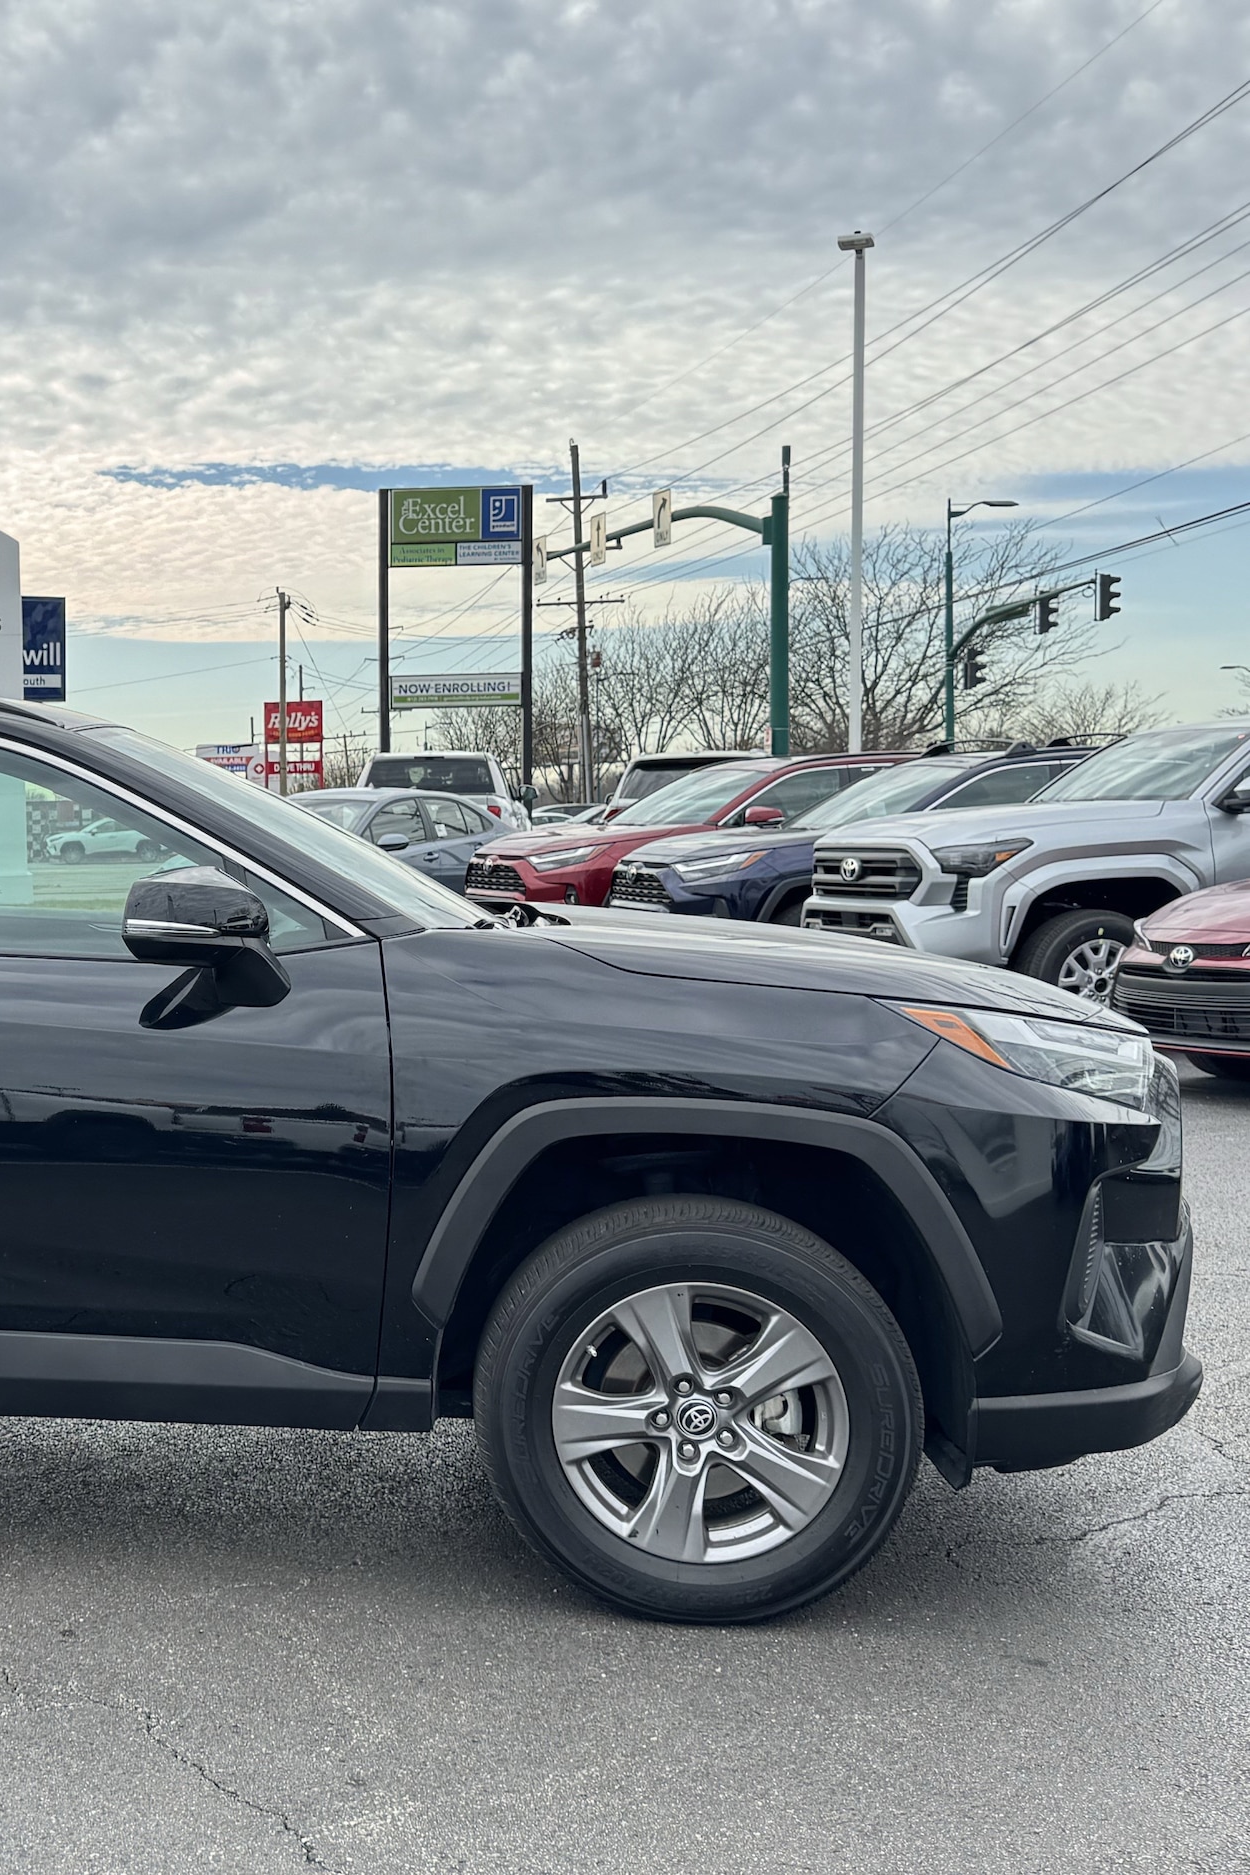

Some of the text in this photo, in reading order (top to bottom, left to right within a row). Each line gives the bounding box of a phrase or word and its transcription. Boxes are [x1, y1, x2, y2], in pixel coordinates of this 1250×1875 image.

[407, 495, 465, 519] Excel
[398, 514, 475, 534] Center
[398, 682, 510, 694] NOW ENROLLING!
[273, 762, 315, 772] DVE THRU
[842, 1361, 896, 1544] SUREDRIVE
